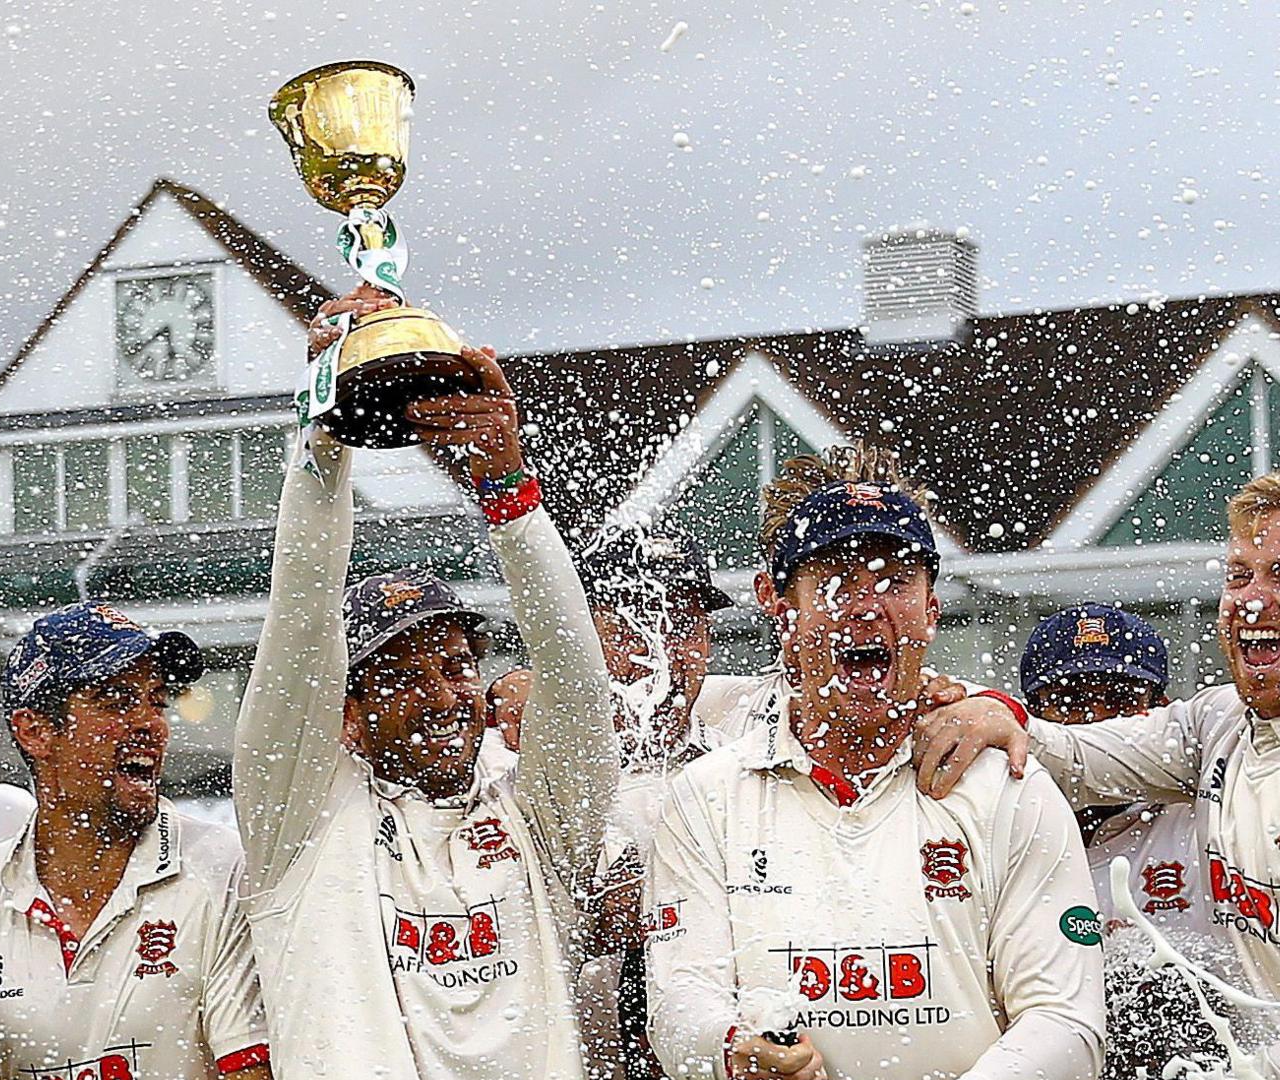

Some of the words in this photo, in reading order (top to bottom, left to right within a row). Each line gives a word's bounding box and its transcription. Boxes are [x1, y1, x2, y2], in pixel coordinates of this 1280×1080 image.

[158, 812, 170, 862] Cloudfm
[794, 954, 926, 1001] D&B
[792, 1008, 910, 1029] AFFOLDING
[916, 1007, 950, 1024] LTD
